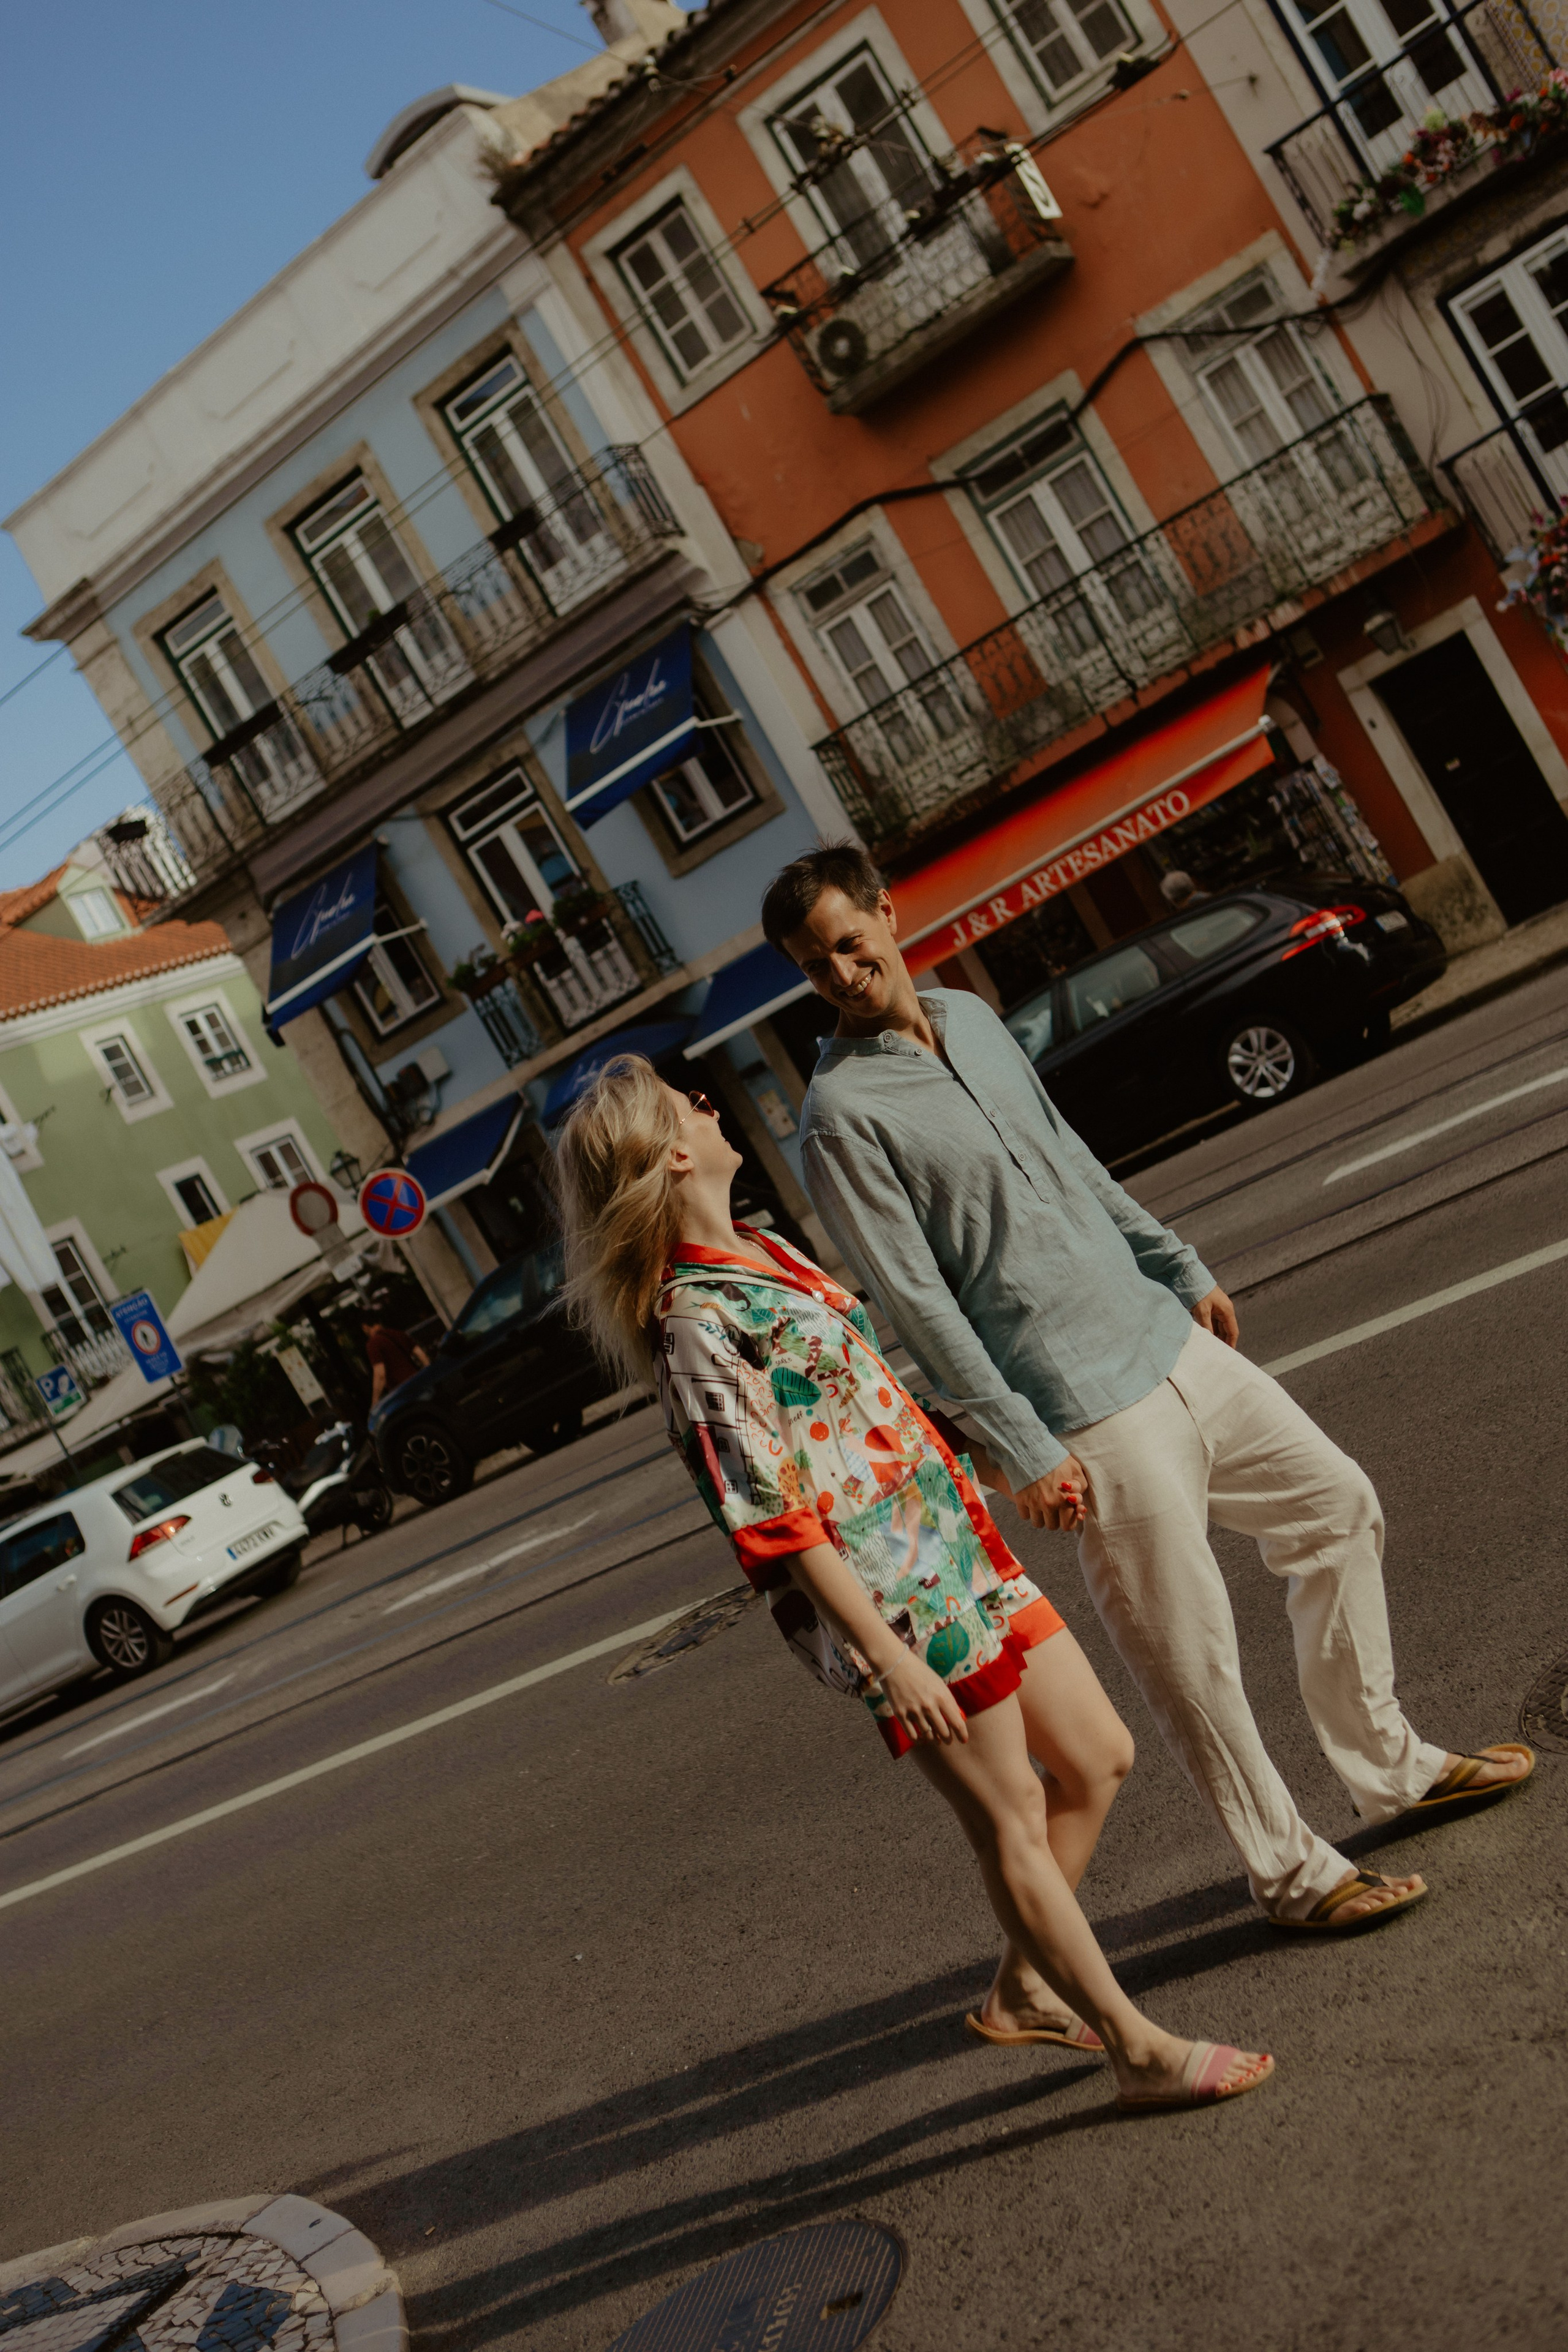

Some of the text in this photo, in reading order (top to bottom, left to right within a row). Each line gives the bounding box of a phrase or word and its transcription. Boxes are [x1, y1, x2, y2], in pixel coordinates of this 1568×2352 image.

[952, 790, 1190, 948] J & R ARTESANATO
[775, 1357, 792, 1366] snake
[40, 1378, 54, 1399] P
